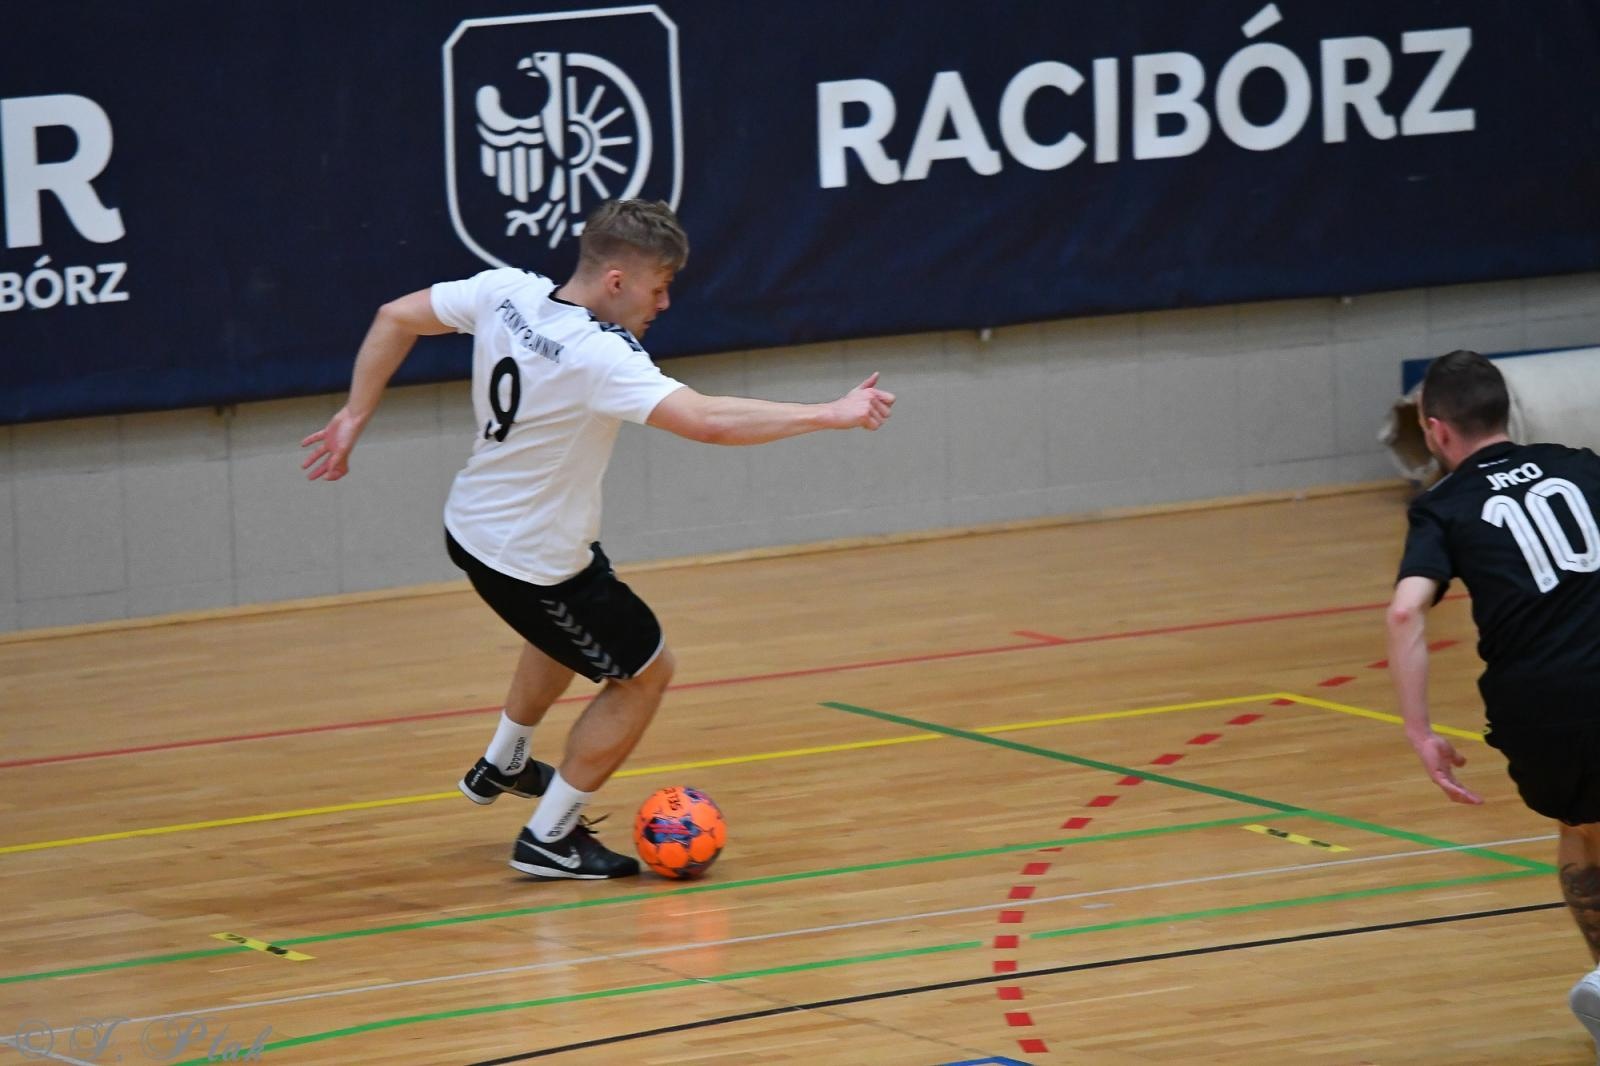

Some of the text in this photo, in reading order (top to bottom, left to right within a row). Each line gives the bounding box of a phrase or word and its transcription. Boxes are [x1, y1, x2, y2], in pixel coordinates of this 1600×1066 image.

[817, 3, 1477, 189] RACIBÓRZ
[0, 94, 126, 249] R
[484, 356, 521, 442] 9
[1486, 462, 1544, 491] JACO
[1481, 477, 1600, 594] 10
